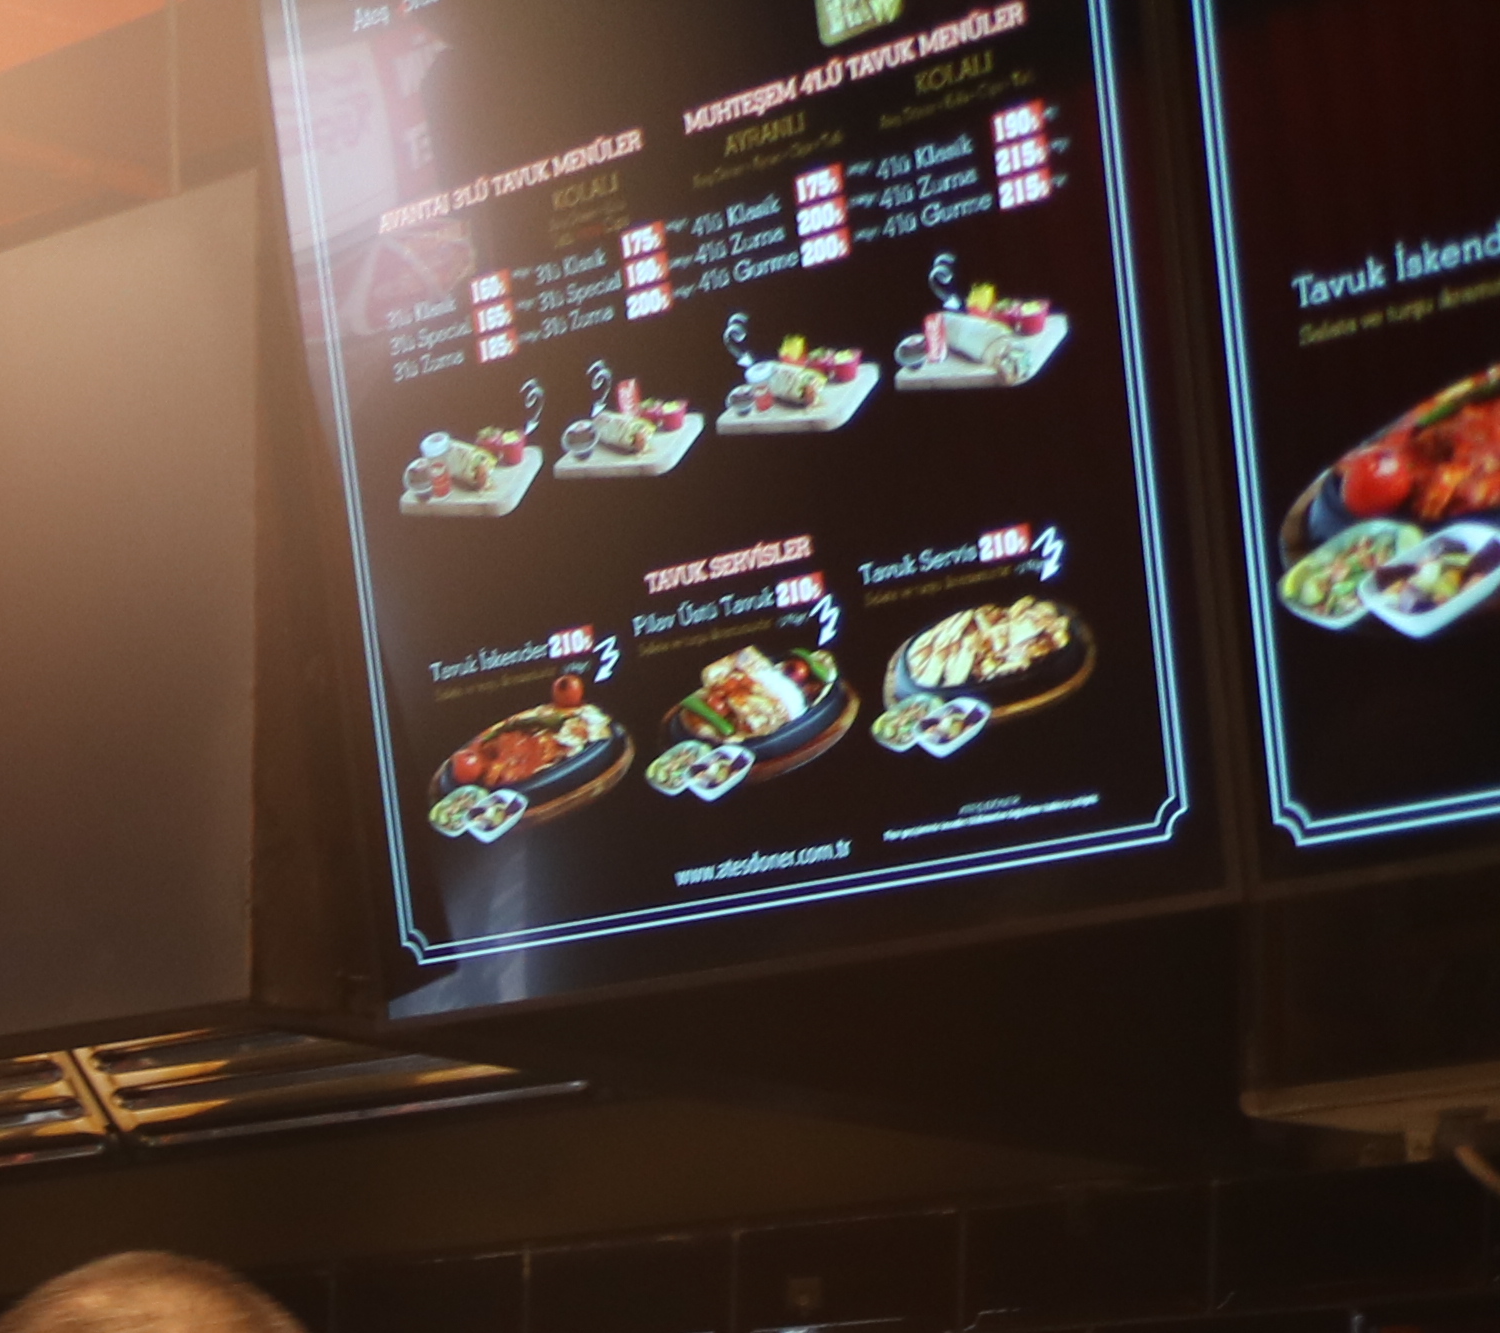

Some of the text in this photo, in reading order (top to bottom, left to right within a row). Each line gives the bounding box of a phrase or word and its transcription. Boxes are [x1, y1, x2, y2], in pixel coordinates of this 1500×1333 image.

[682, 79, 798, 135] MUHTEŞEM
[845, 40, 917, 82] TAVUK
[918, 1, 1026, 57] MENÜLER
[491, 158, 551, 196] TAVUK
[550, 128, 644, 177] MENÜLER
[916, 167, 978, 199] Zurna
[920, 193, 993, 226] Gurme
[729, 226, 786, 256] Zurna
[732, 251, 800, 283] Gurme
[1291, 256, 1386, 308] Tavuk
[644, 534, 814, 594] TAVUK SERVİSLER
[858, 554, 916, 585] Tavuk
[918, 543, 977, 572] Servis
[632, 613, 676, 637] Pilav
[719, 585, 774, 616] Tavuk
[429, 654, 478, 682] Tavuk
[674, 838, 852, 887] www.atesdoner.com.tr
